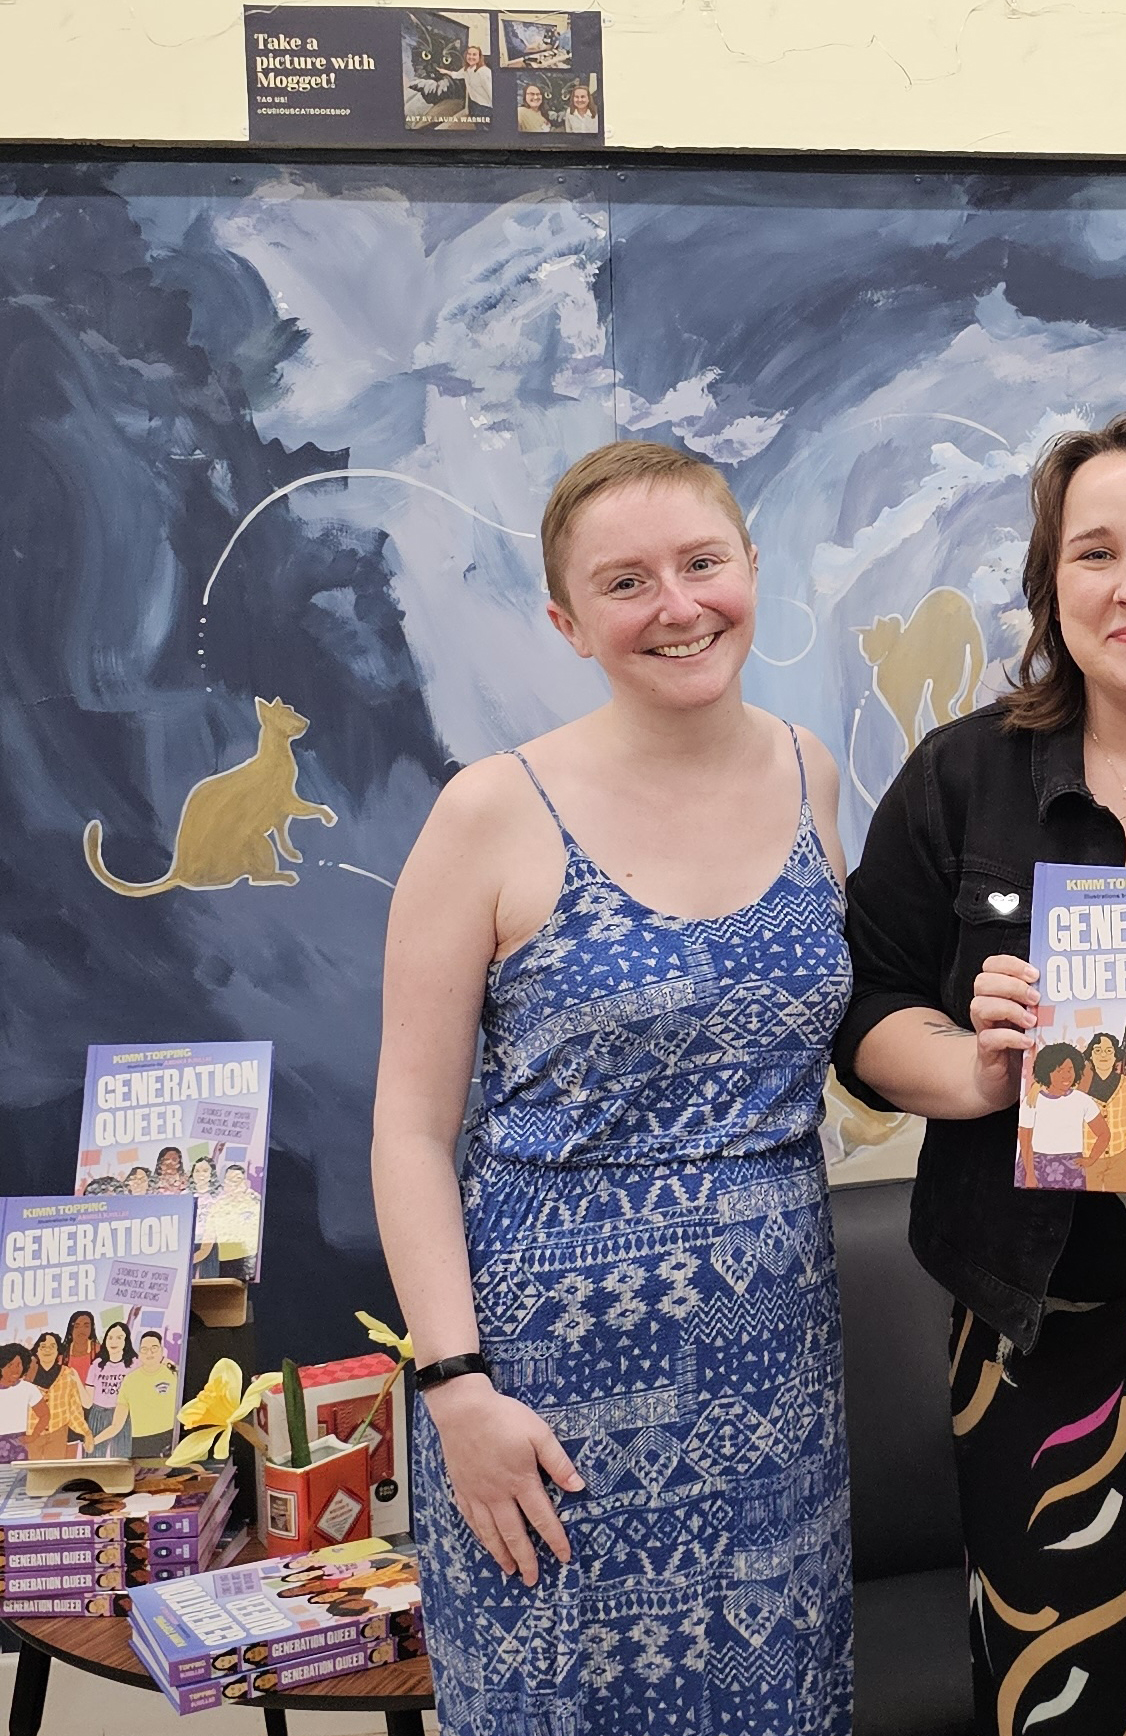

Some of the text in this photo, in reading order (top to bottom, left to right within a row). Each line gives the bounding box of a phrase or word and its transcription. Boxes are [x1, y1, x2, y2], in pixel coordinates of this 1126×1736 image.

[254, 33, 318, 50] Take a
[256, 53, 375, 71] picture with
[256, 72, 336, 92] Mogget!
[1066, 879, 1105, 890] KIMM
[113, 1053, 144, 1065] KIMM
[145, 1048, 192, 1061] TOPPING
[98, 1060, 258, 1109] GENERATION
[95, 1105, 183, 1147] QUEER
[23, 1201, 107, 1218] KIMM TOPPING
[5, 1214, 179, 1269] GENERATION
[2, 1263, 96, 1309] QUEER
[8, 1525, 91, 1543] GENERATION QUEER
[9, 1551, 92, 1568] GENERATION QUEER
[9, 1575, 92, 1592] GENERATION QUEER
[3, 1599, 81, 1613] GENERATION QUEER
[153, 1579, 247, 1646] GENERATION
[225, 1594, 293, 1635] QUEER
[271, 1626, 357, 1657] GENERATION QUEER
[281, 1652, 365, 1684] GENERATION QUEER
